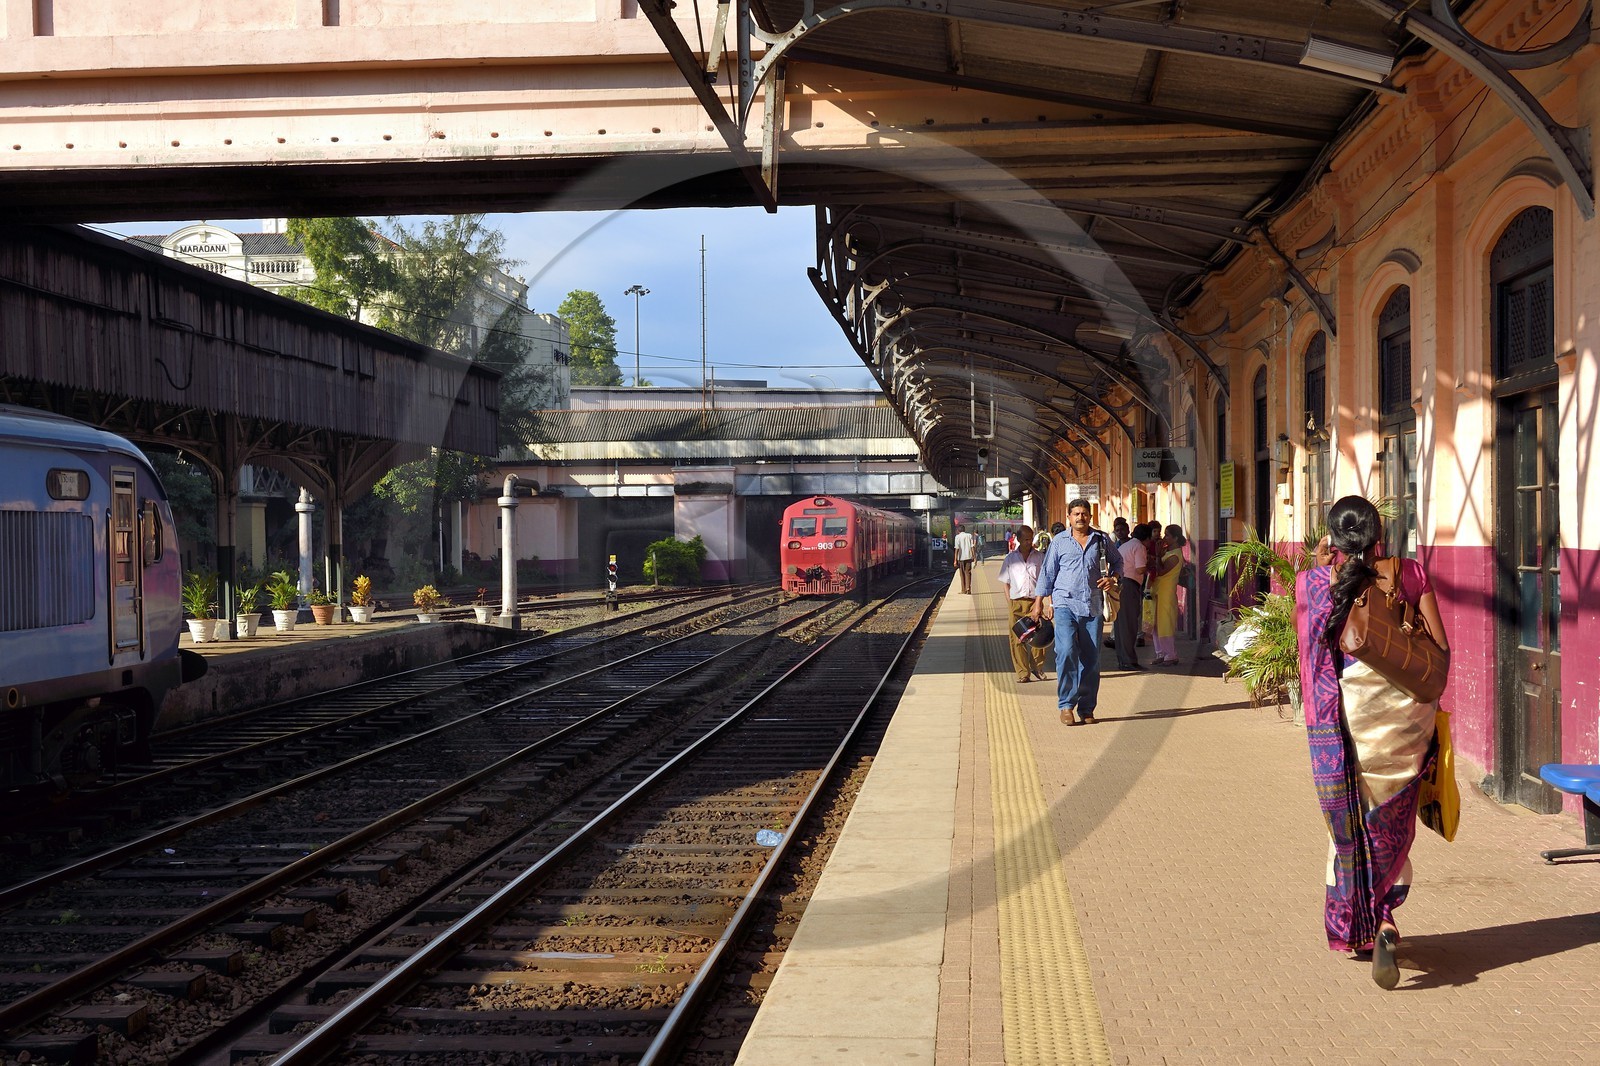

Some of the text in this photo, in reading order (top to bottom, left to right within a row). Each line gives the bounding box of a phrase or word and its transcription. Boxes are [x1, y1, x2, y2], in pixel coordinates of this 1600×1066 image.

[180, 244, 227, 253] MARADANA
[993, 481, 1002, 497] 6
[818, 542, 833, 550] 903
